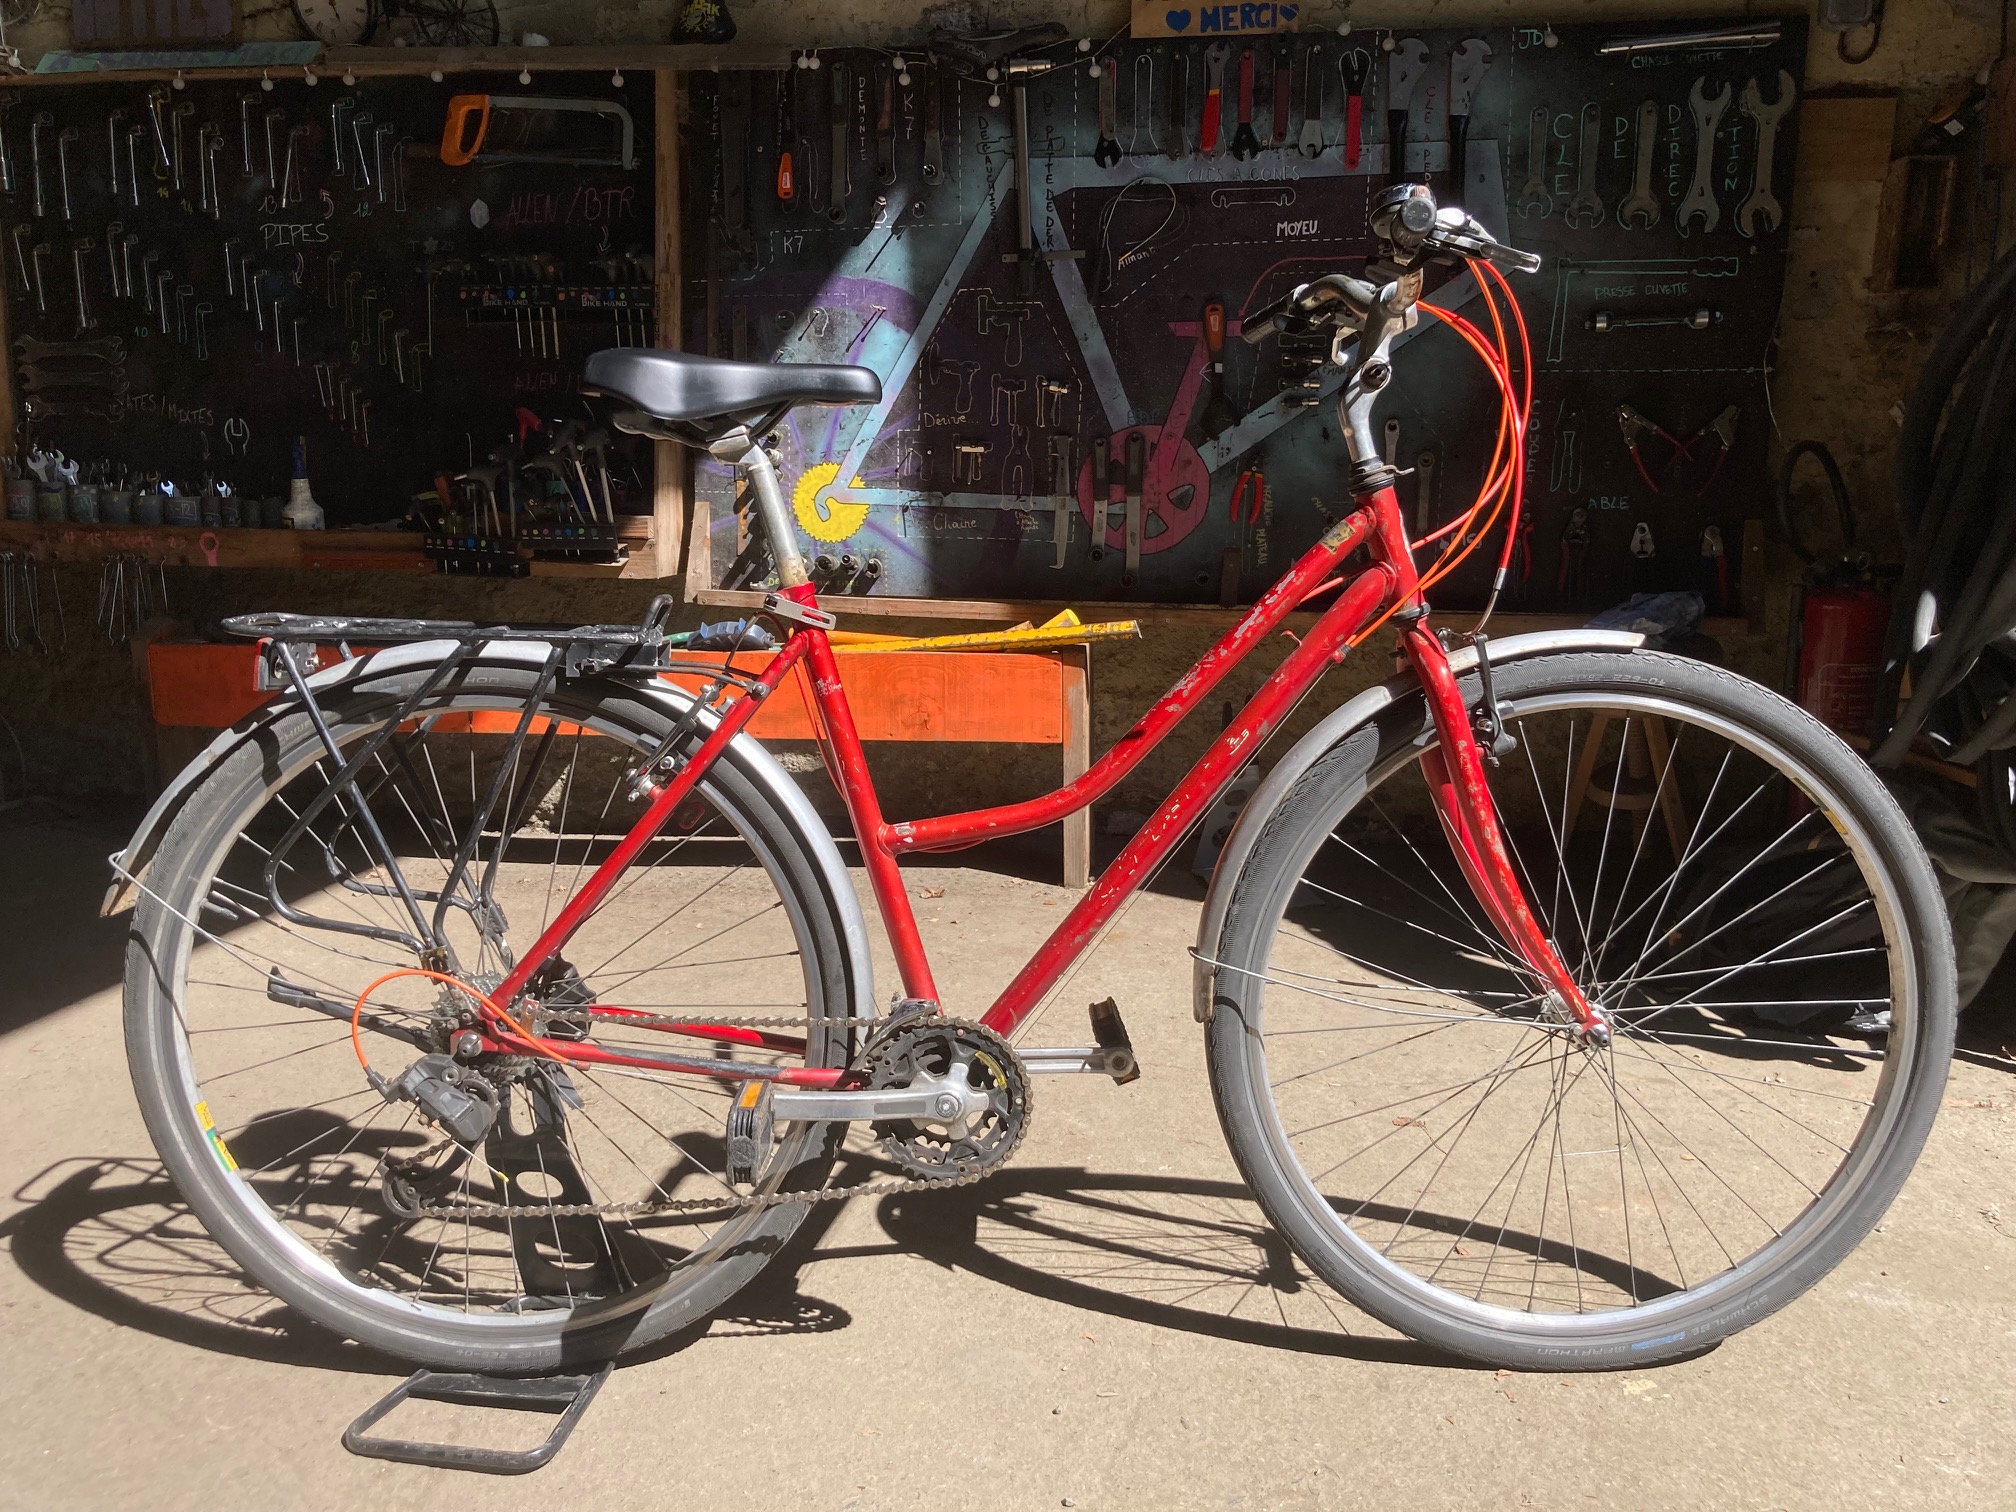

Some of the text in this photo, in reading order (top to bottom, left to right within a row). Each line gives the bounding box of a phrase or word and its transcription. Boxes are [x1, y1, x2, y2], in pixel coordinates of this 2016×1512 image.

[1201, 3, 1278, 33] MERCI
[1613, 116, 1629, 160] DE
[260, 223, 329, 250] PIPES
[783, 235, 804, 255] K7
[1594, 282, 1689, 301] PRESSE CUVETTE
